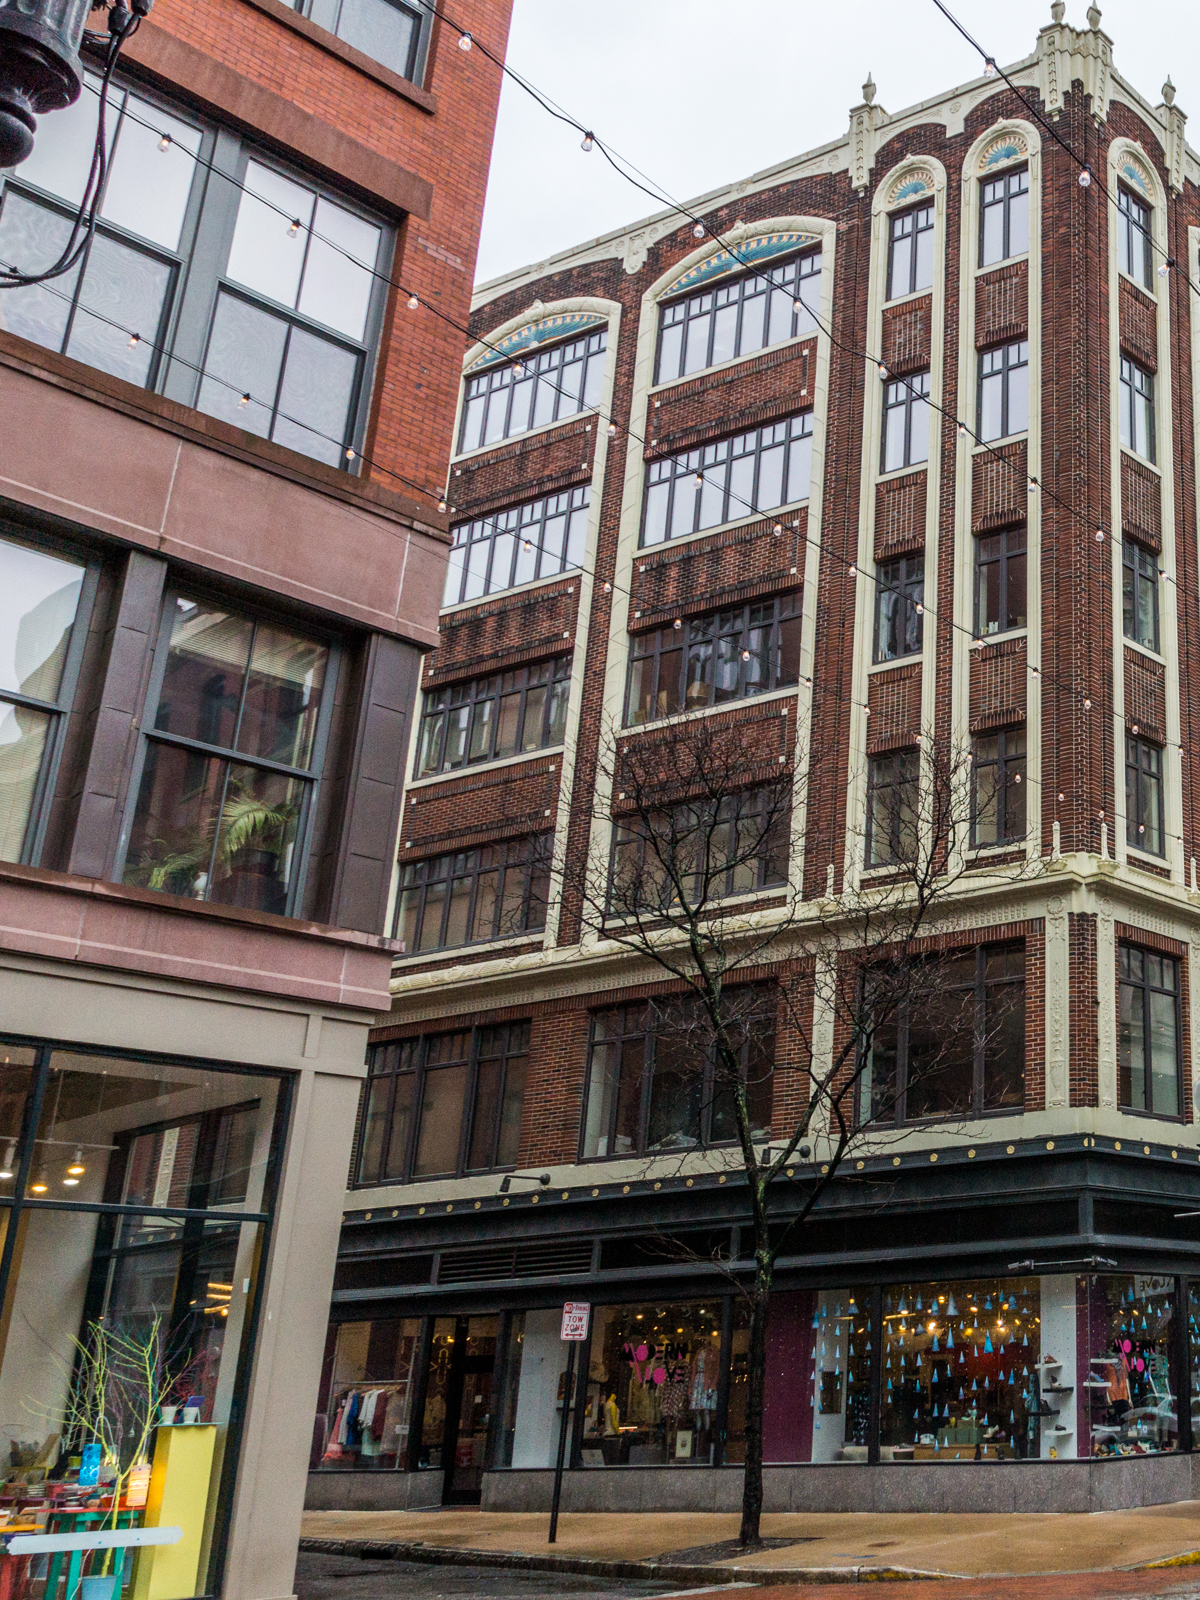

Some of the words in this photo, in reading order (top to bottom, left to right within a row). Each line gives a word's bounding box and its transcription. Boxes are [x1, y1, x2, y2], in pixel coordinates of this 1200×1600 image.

[568, 1315, 584, 1324] TOW
[564, 1323, 585, 1332] ZONE
[621, 1343, 688, 1362] MODERN
[645, 1363, 685, 1385] LOVE
